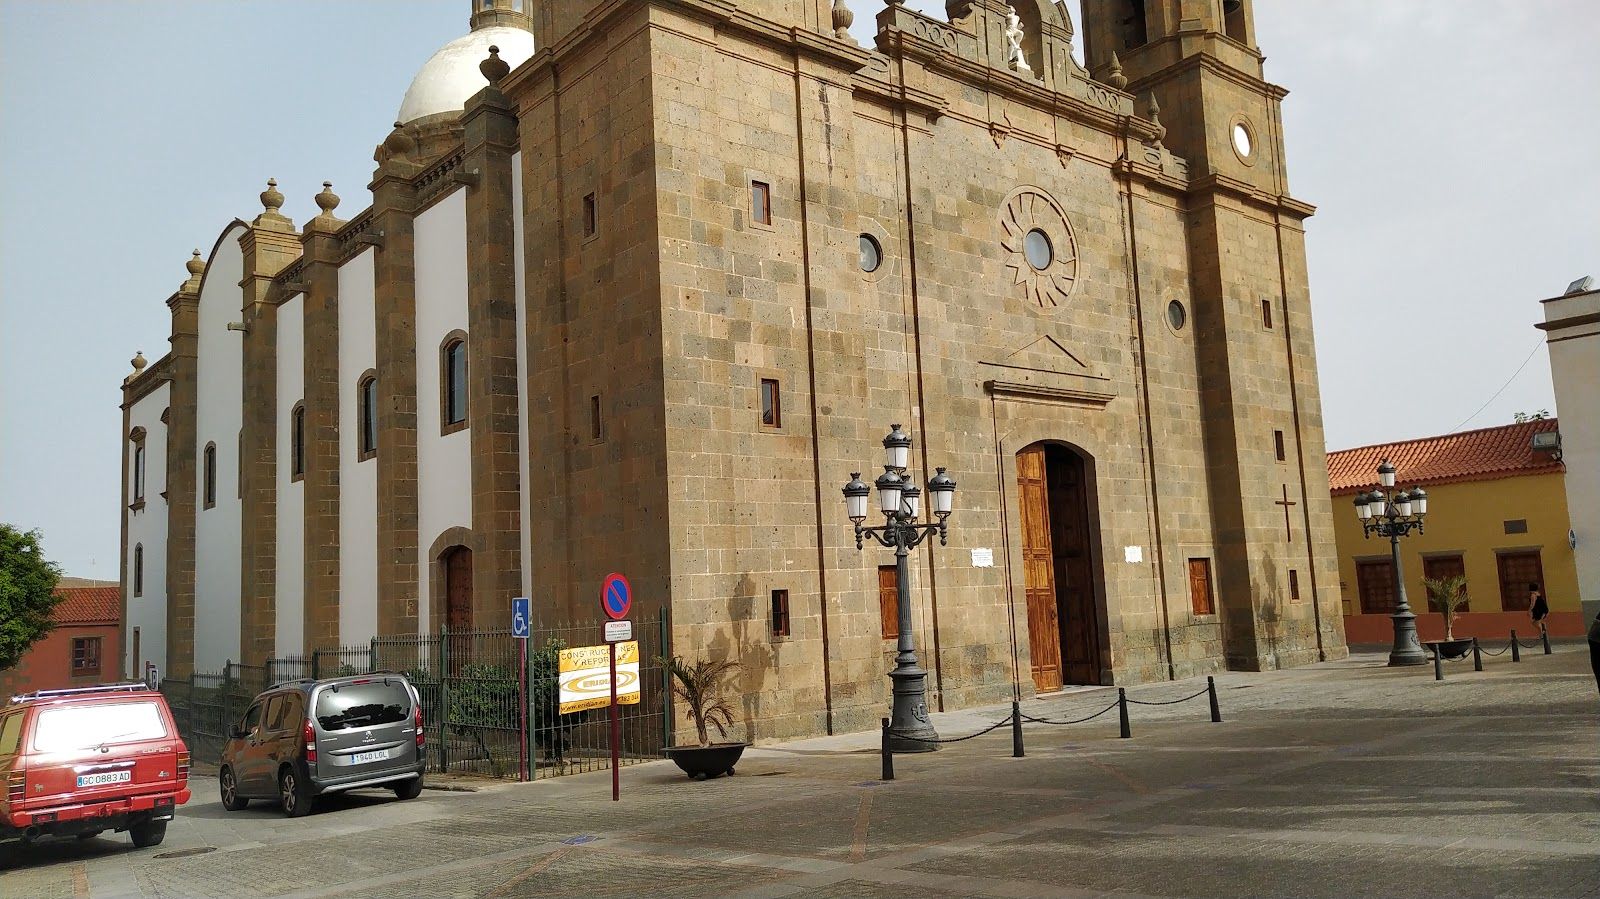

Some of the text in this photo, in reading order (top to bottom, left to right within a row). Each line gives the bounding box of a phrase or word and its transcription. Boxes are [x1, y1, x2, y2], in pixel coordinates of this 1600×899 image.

[561, 644, 635, 660] CONSTRUCCNES
[581, 653, 626, 666] REFORAS
[82, 772, 130, 785] GC 0883 AD
